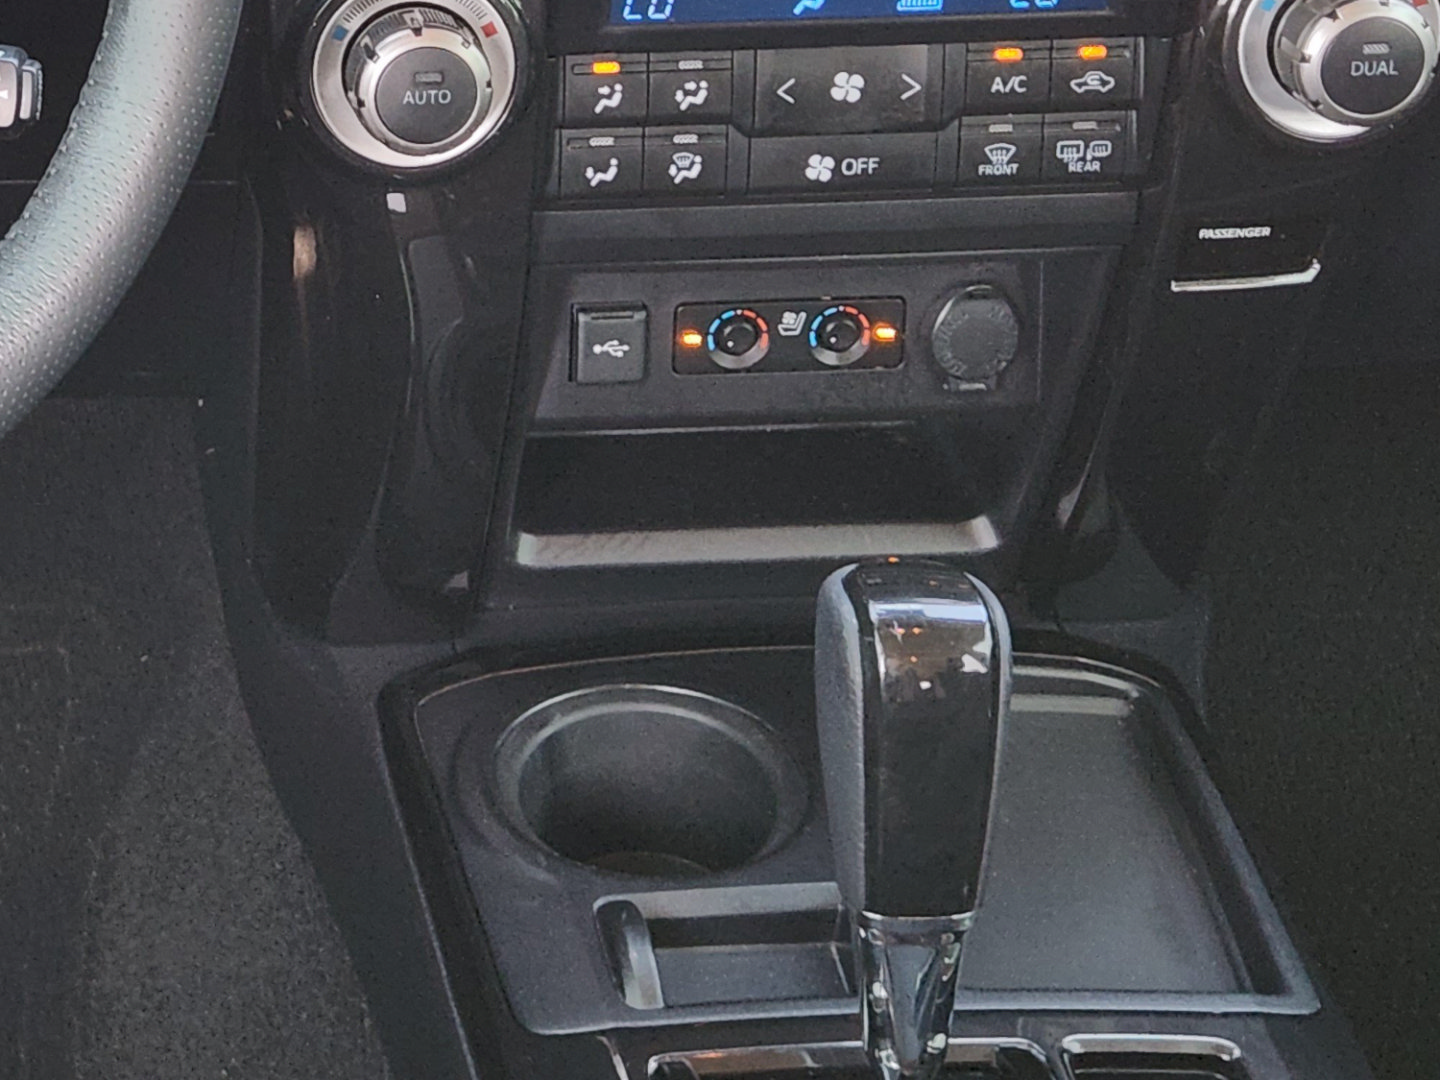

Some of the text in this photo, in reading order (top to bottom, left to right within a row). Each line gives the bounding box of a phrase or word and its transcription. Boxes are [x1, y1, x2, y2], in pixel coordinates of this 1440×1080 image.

[1350, 58, 1399, 78] DUAL
[990, 74, 1028, 96] A/C
[402, 89, 452, 106] AUTO
[840, 157, 880, 177] OFF
[977, 162, 1020, 178] FRONT
[1067, 156, 1101, 174] REAR
[1198, 225, 1272, 240] PASSENGER
